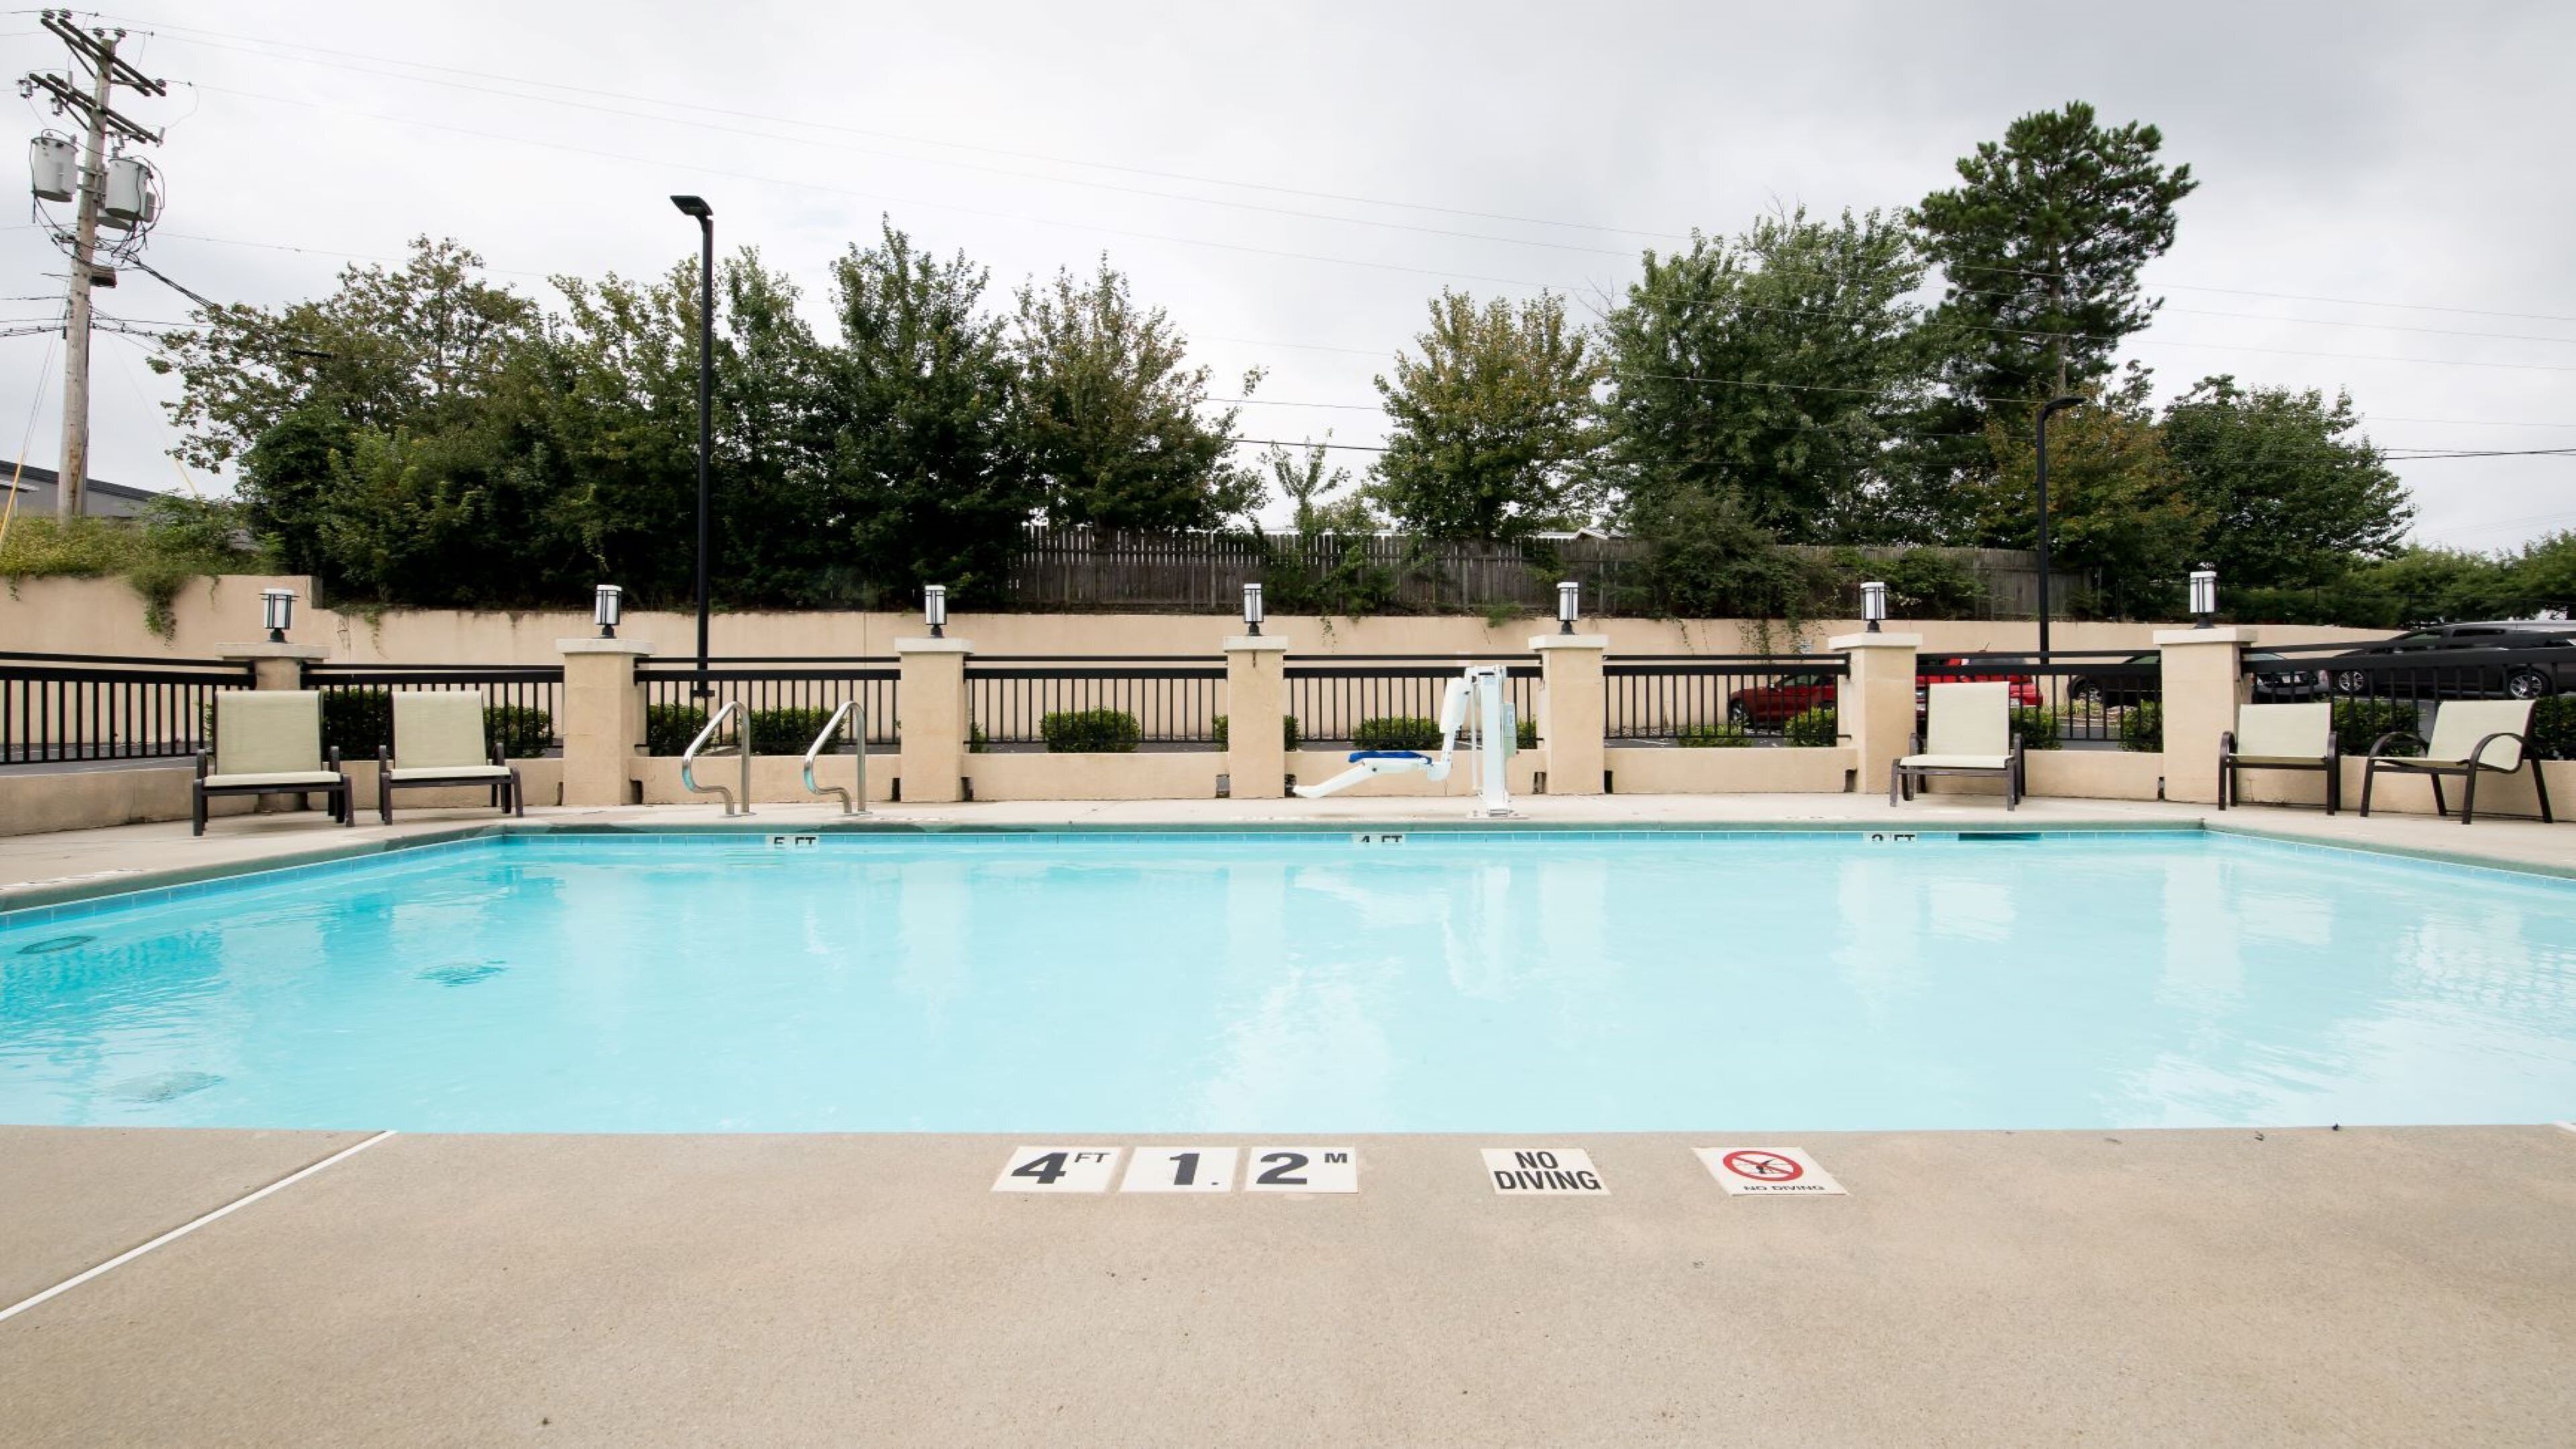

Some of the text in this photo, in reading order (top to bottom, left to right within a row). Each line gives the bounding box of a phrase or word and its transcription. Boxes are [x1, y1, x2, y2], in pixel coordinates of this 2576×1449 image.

[1011, 1152, 1069, 1185] 4
[1075, 1152, 1111, 1163] FT
[1324, 1152, 1348, 1163] M
[1514, 1151, 1559, 1169] NO
[1494, 1170, 1602, 1191] DIVING
